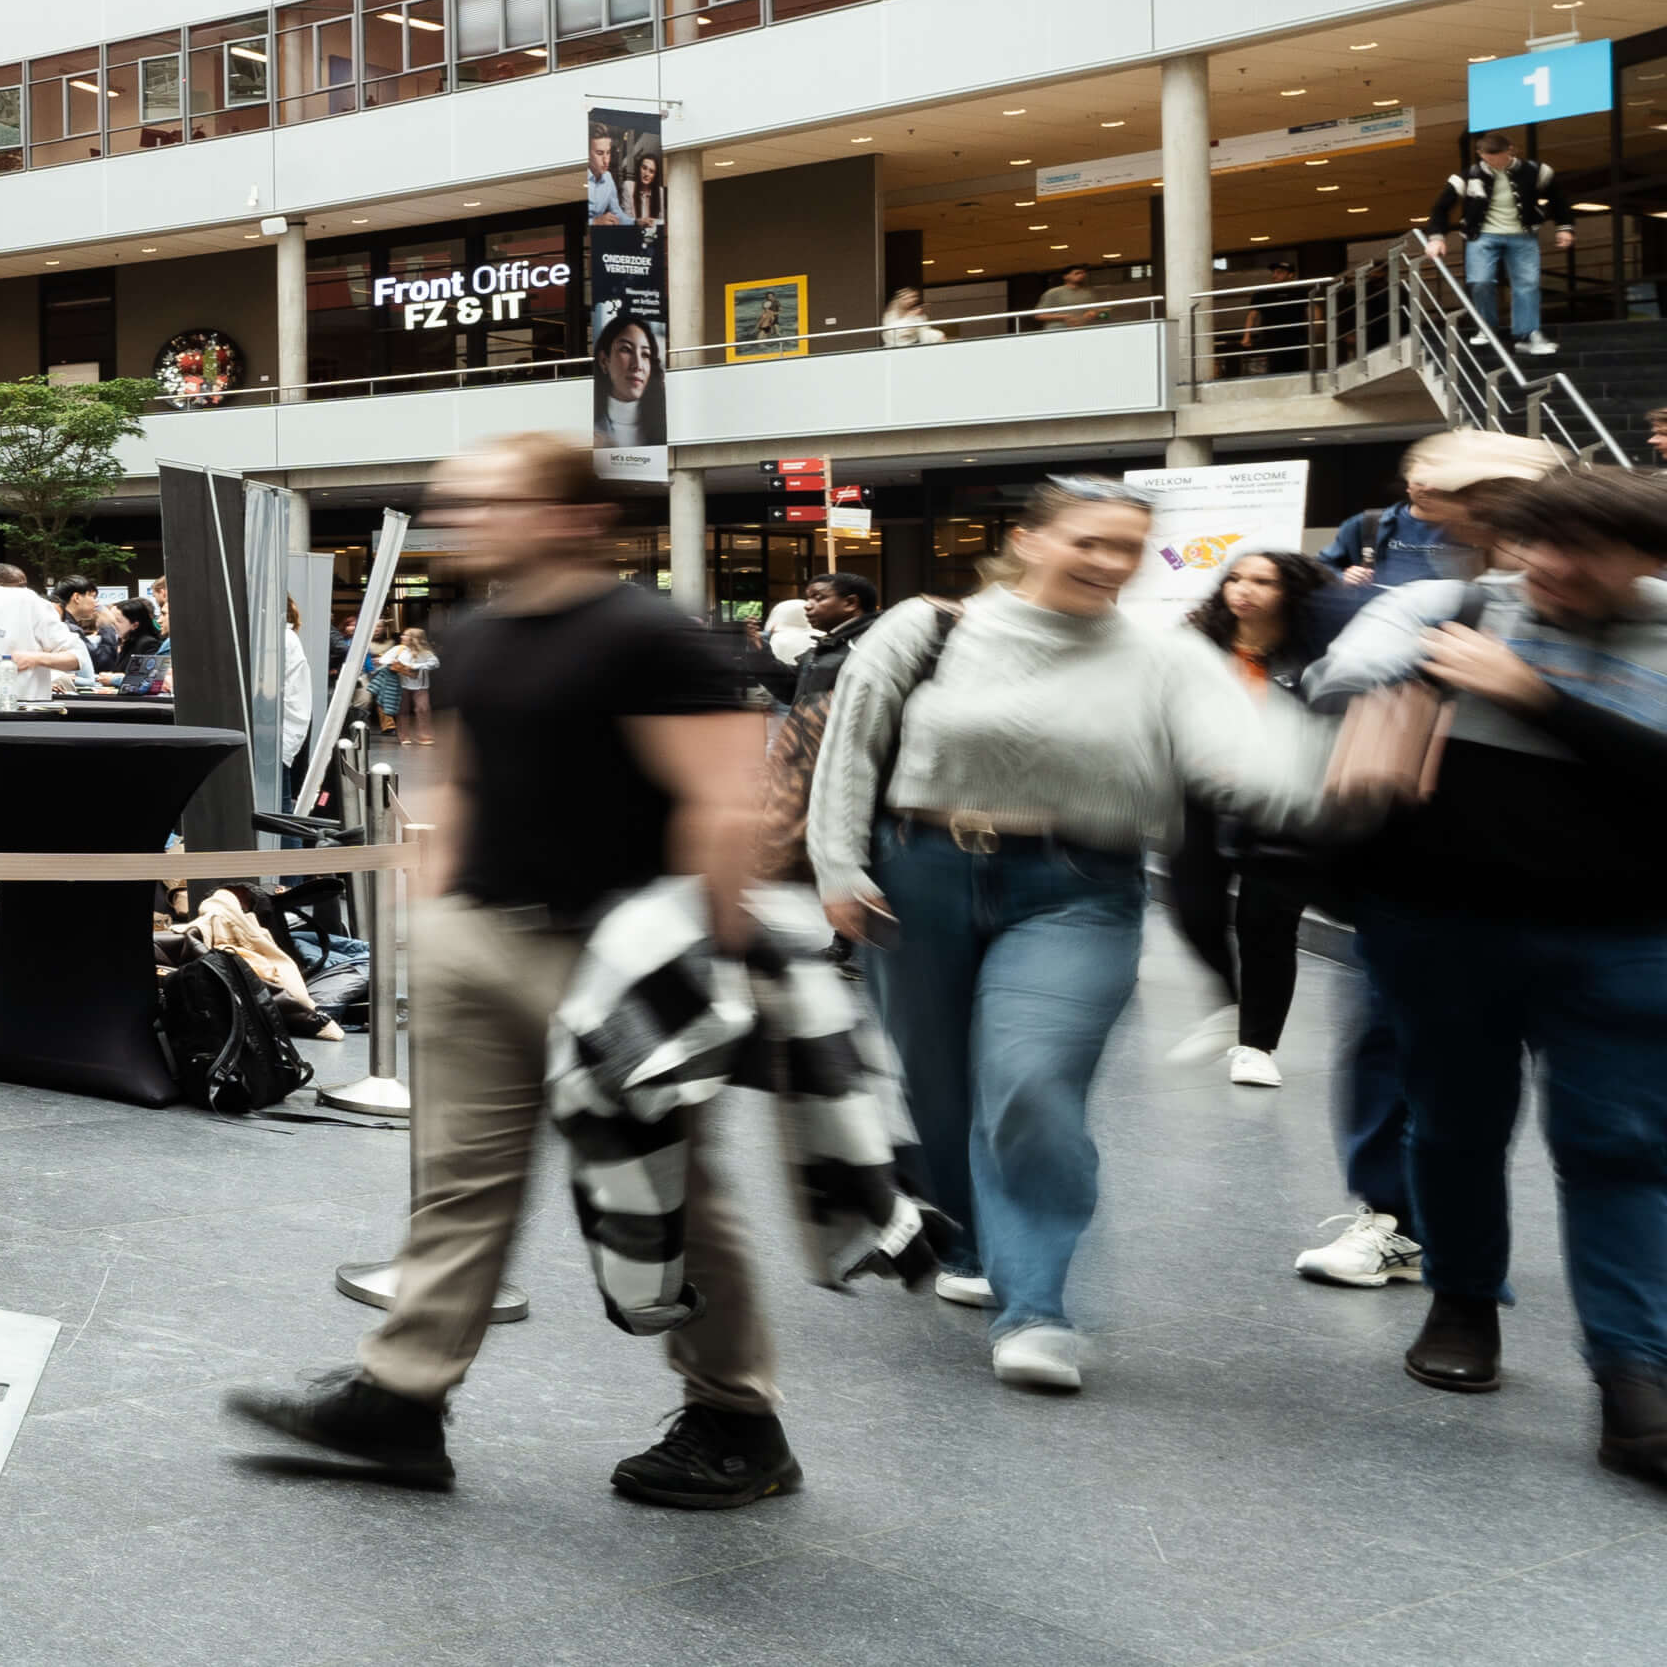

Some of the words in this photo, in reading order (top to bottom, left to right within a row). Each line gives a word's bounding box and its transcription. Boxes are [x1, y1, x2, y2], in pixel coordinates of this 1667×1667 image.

[1523, 65, 1551, 107] 1
[373, 271, 465, 306] Front
[472, 260, 571, 294] Office
[404, 300, 448, 330] FZ
[456, 296, 483, 325] &
[492, 291, 527, 321] IT
[1144, 476, 1193, 487] WELKOM
[1229, 470, 1288, 483] WELCOME
